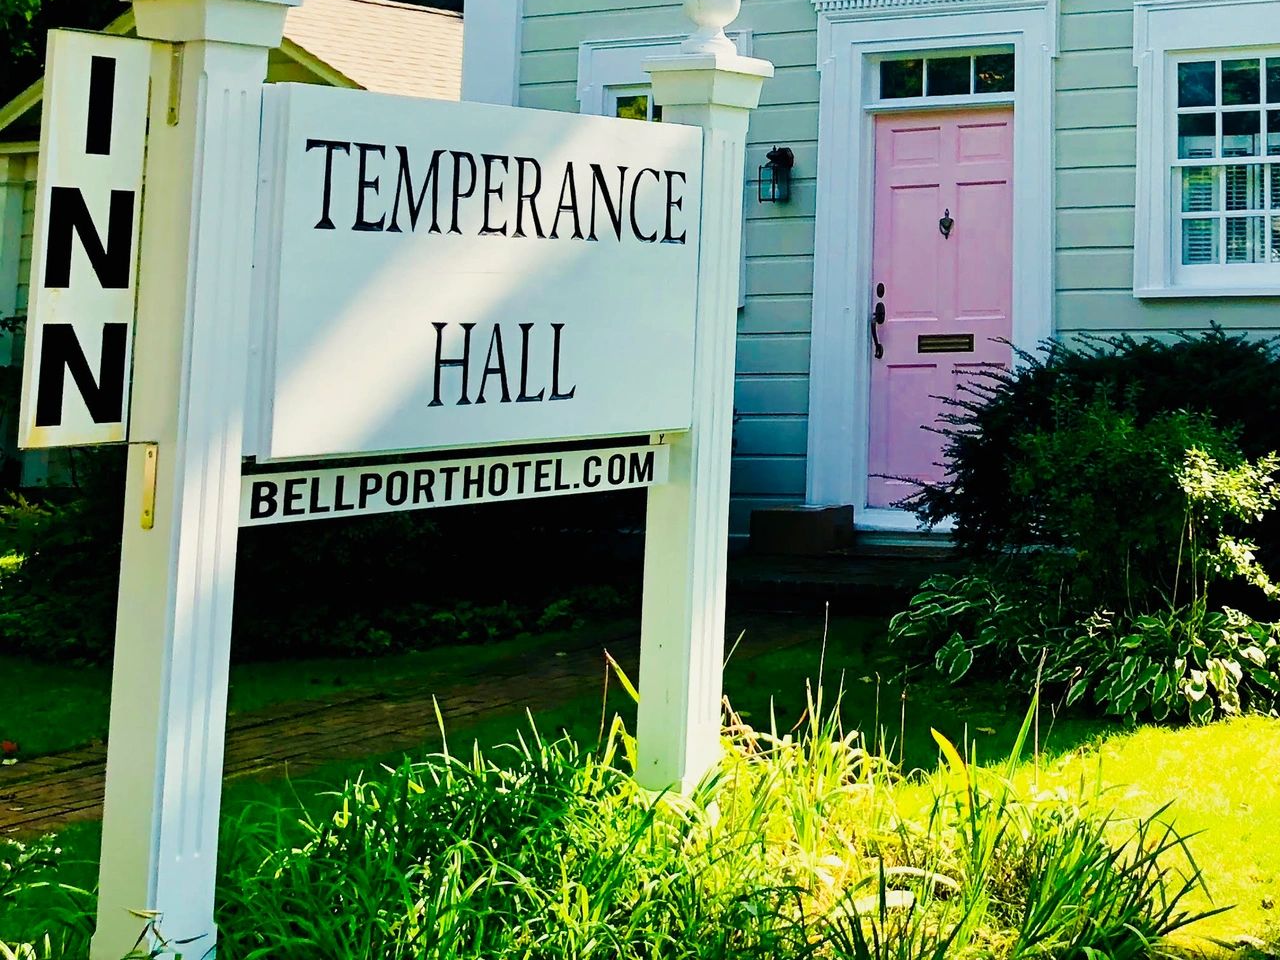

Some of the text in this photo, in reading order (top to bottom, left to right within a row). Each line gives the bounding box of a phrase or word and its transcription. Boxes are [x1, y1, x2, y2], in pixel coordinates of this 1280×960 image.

[305, 138, 687, 244] TEMPERANCE
[35, 55, 135, 427] INN
[427, 322, 576, 407] HALL
[249, 451, 655, 519] BELLPORTHOTEL.COM
